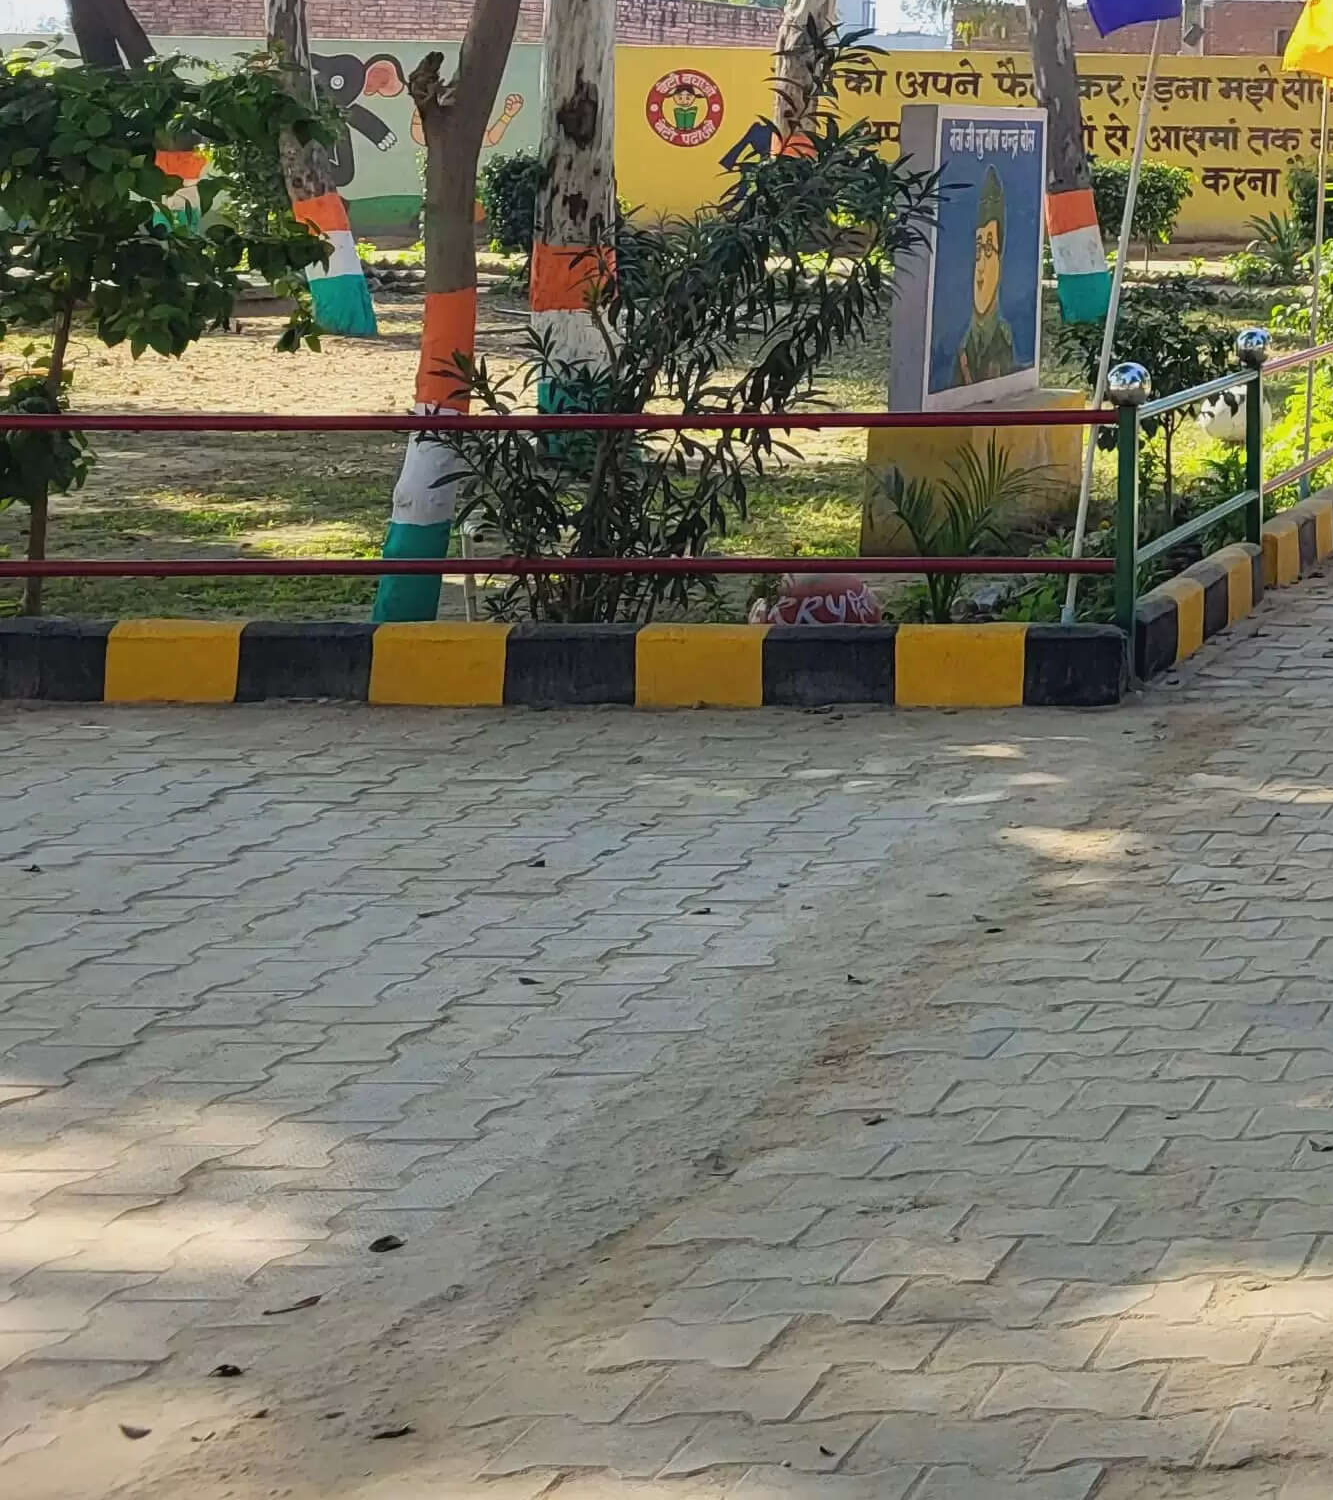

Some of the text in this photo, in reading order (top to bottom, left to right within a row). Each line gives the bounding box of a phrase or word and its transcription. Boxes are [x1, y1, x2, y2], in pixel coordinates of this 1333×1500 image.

[895, 58, 983, 99] अपने
[1247, 126, 1303, 156] तक
[1201, 166, 1283, 201] करना
